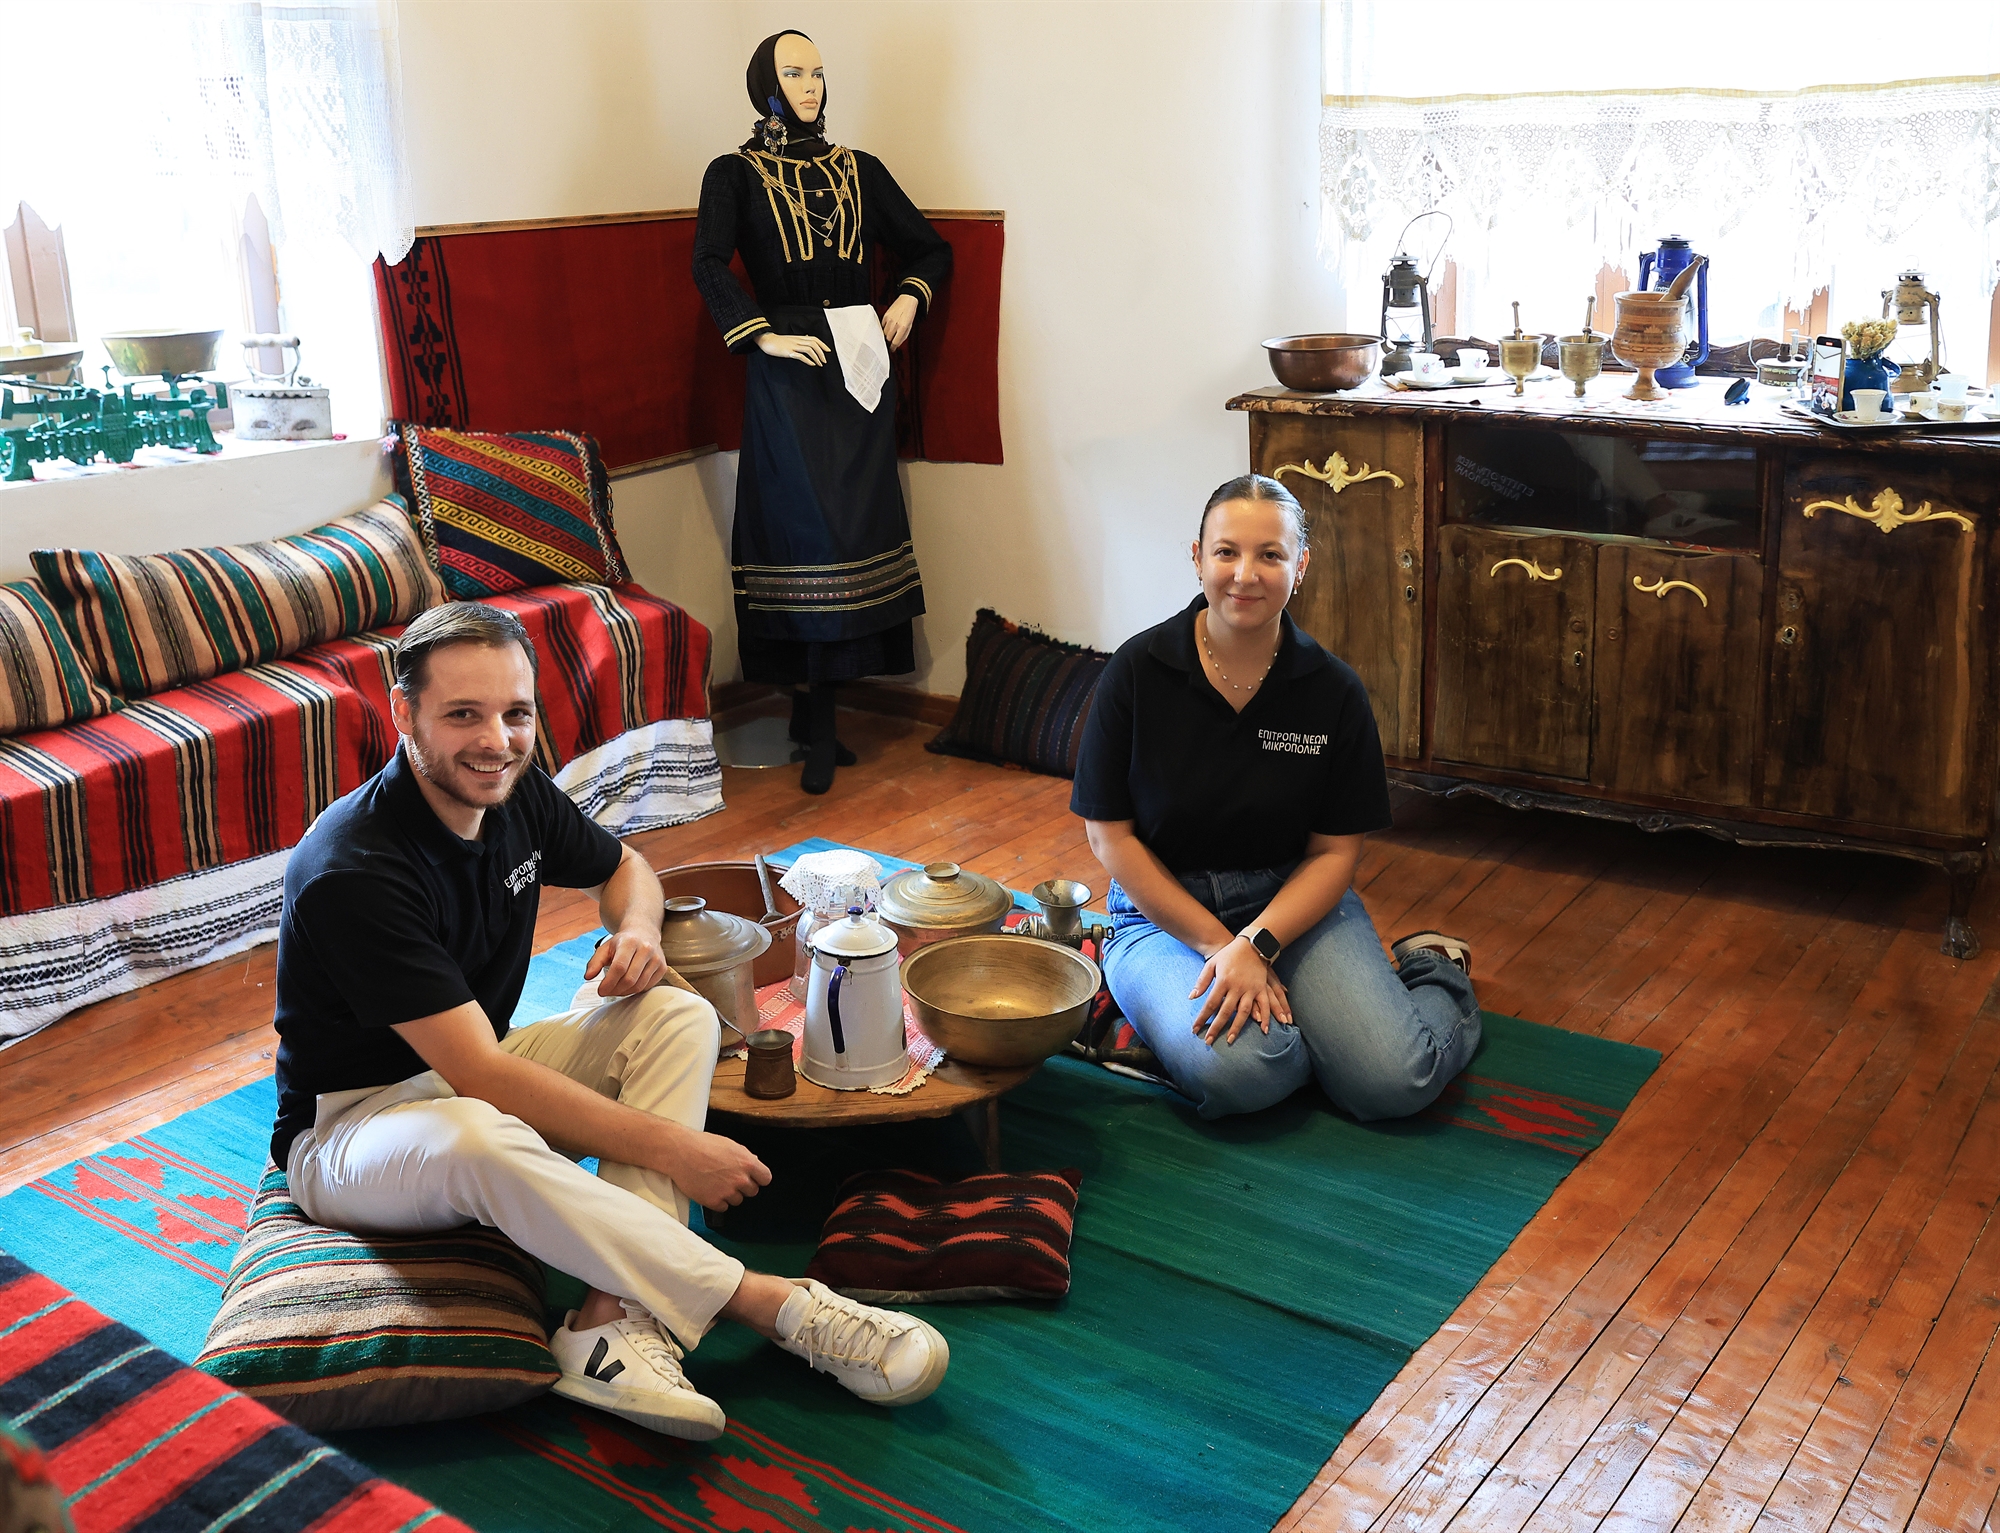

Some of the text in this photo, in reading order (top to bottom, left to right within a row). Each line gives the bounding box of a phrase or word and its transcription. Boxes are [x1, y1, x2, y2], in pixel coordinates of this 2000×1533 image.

[1258, 729, 1328, 745] ΕΠΙΤΡΟΠΗ ΝΕΩΝ
[1262, 740, 1321, 755] ΜΙΚΡΟΠΟΛΗΣ
